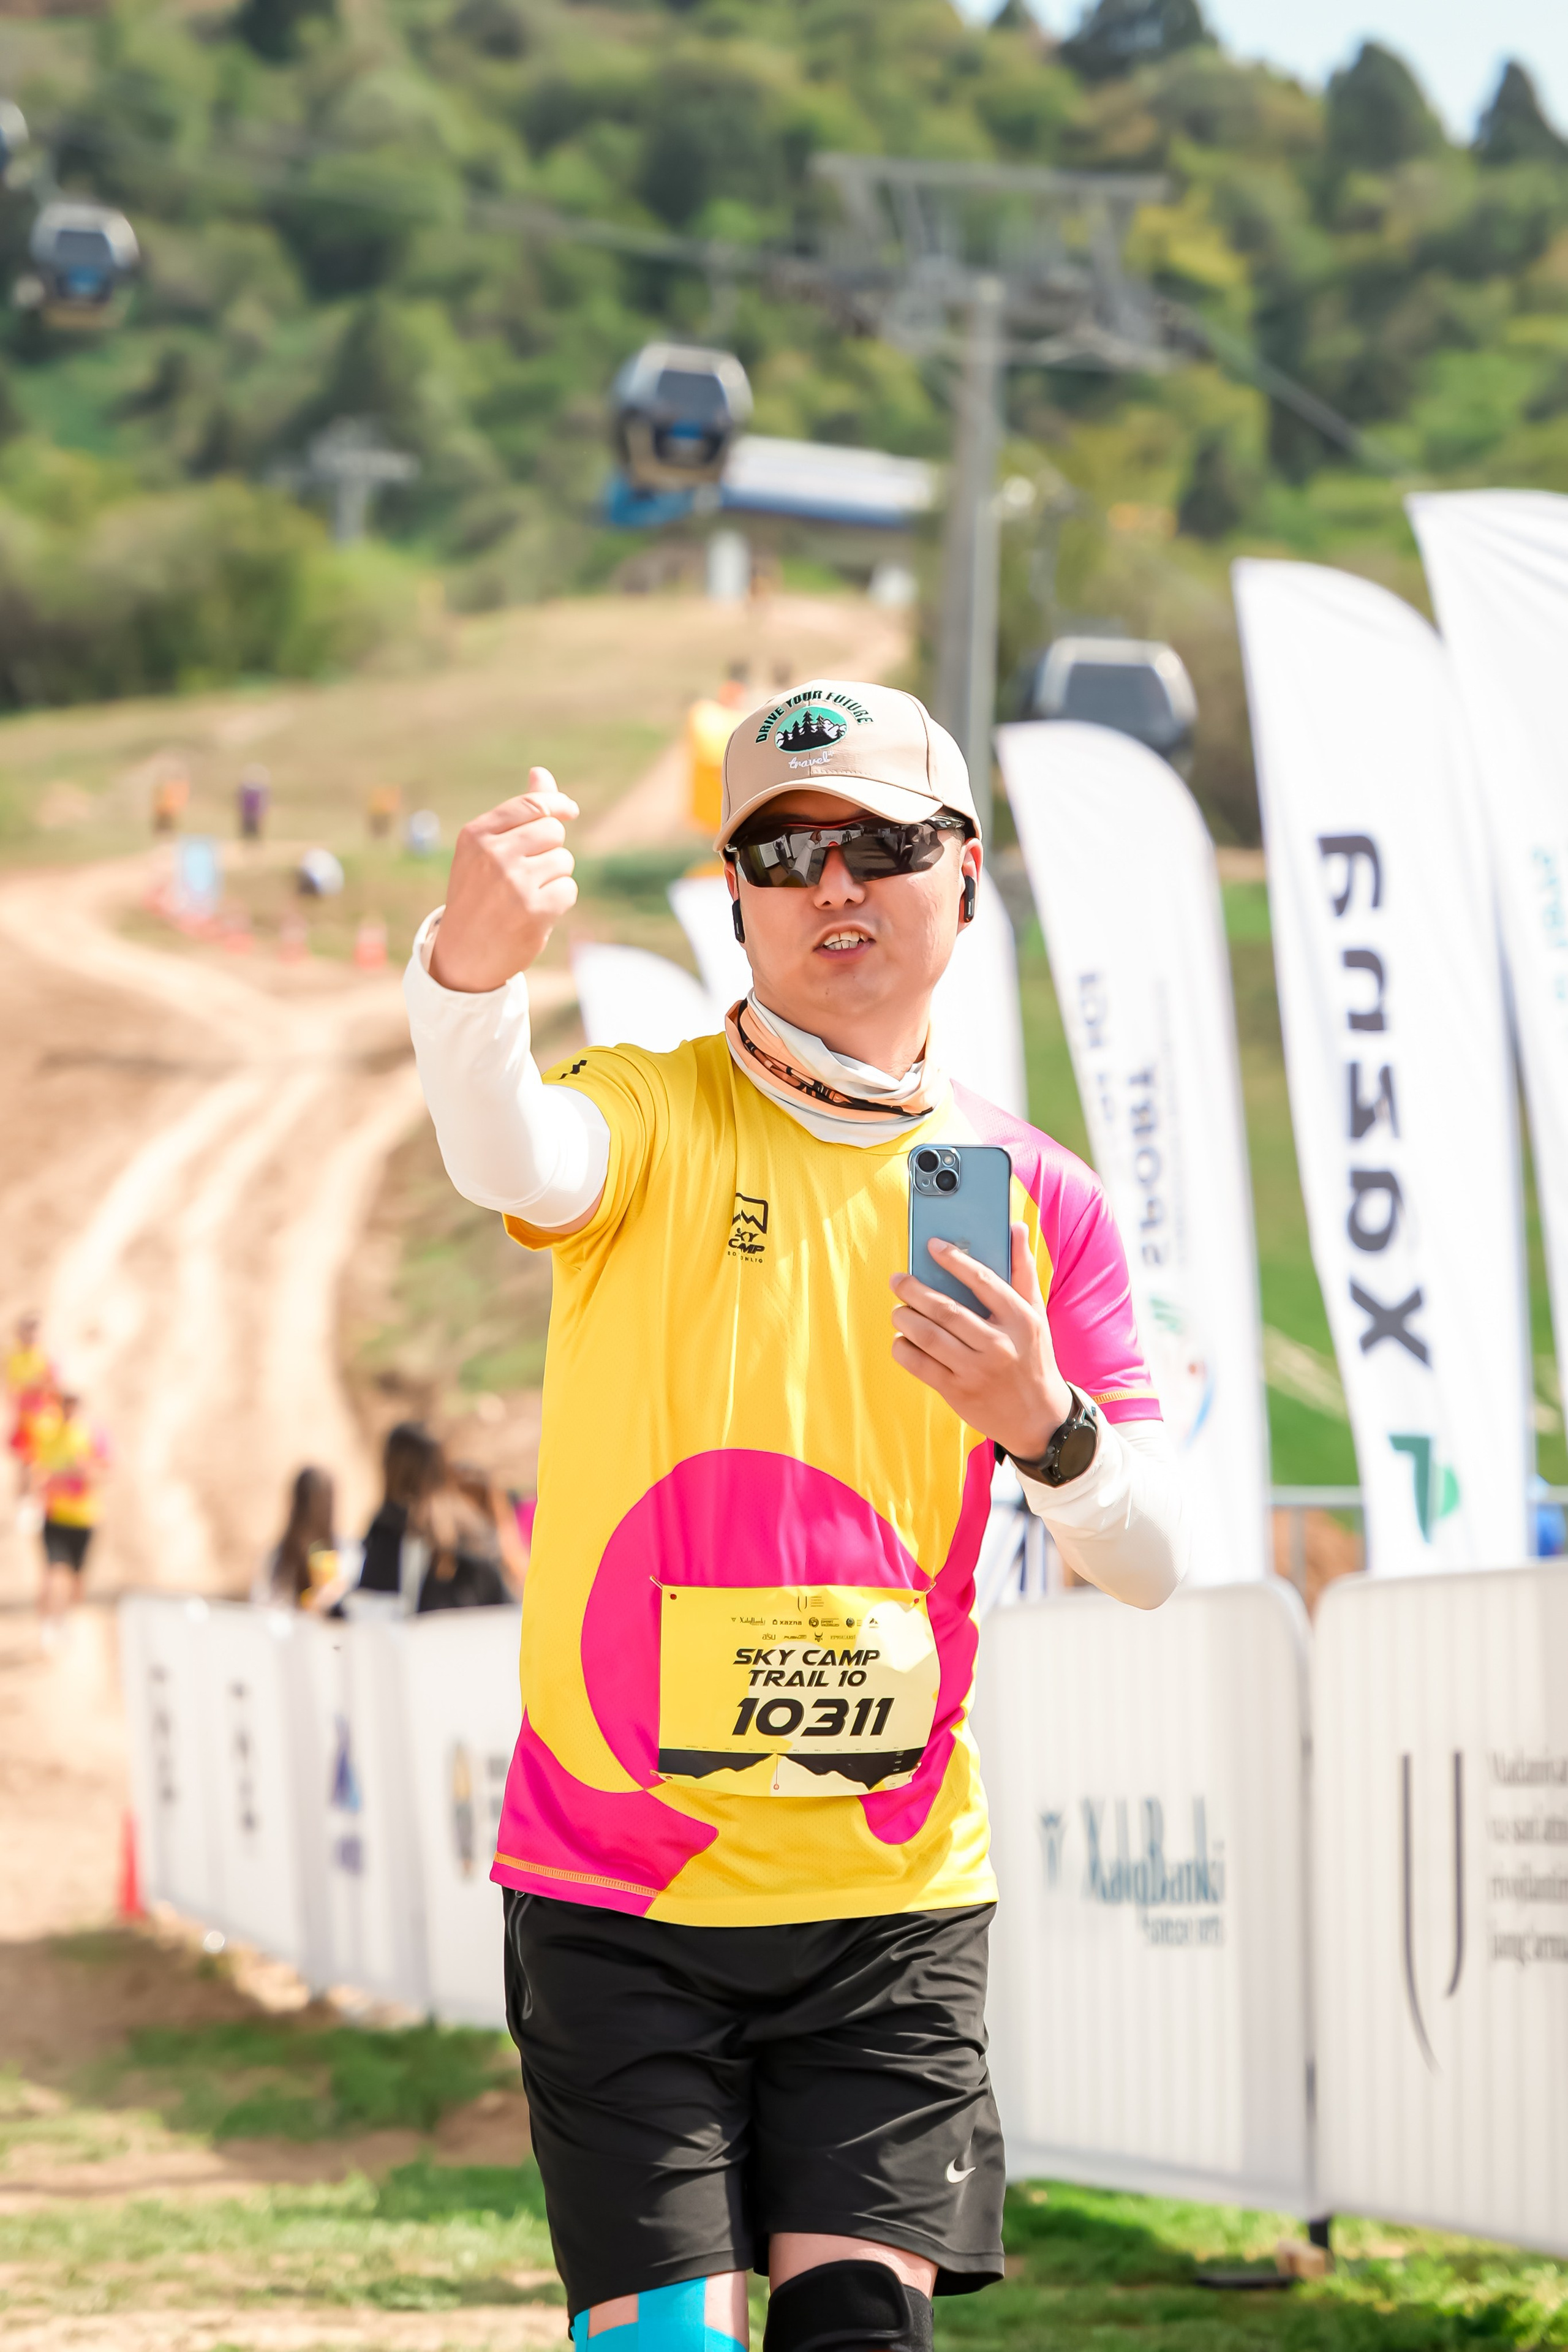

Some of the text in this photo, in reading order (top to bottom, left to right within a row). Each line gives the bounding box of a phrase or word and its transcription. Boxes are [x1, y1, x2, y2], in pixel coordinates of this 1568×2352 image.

[756, 691, 873, 743] DRIVE YOUR FUTURE
[733, 1648, 880, 1666] SKY CAMP
[748, 1670, 867, 1687] TRAIL 10
[732, 1698, 894, 1737] 10311
